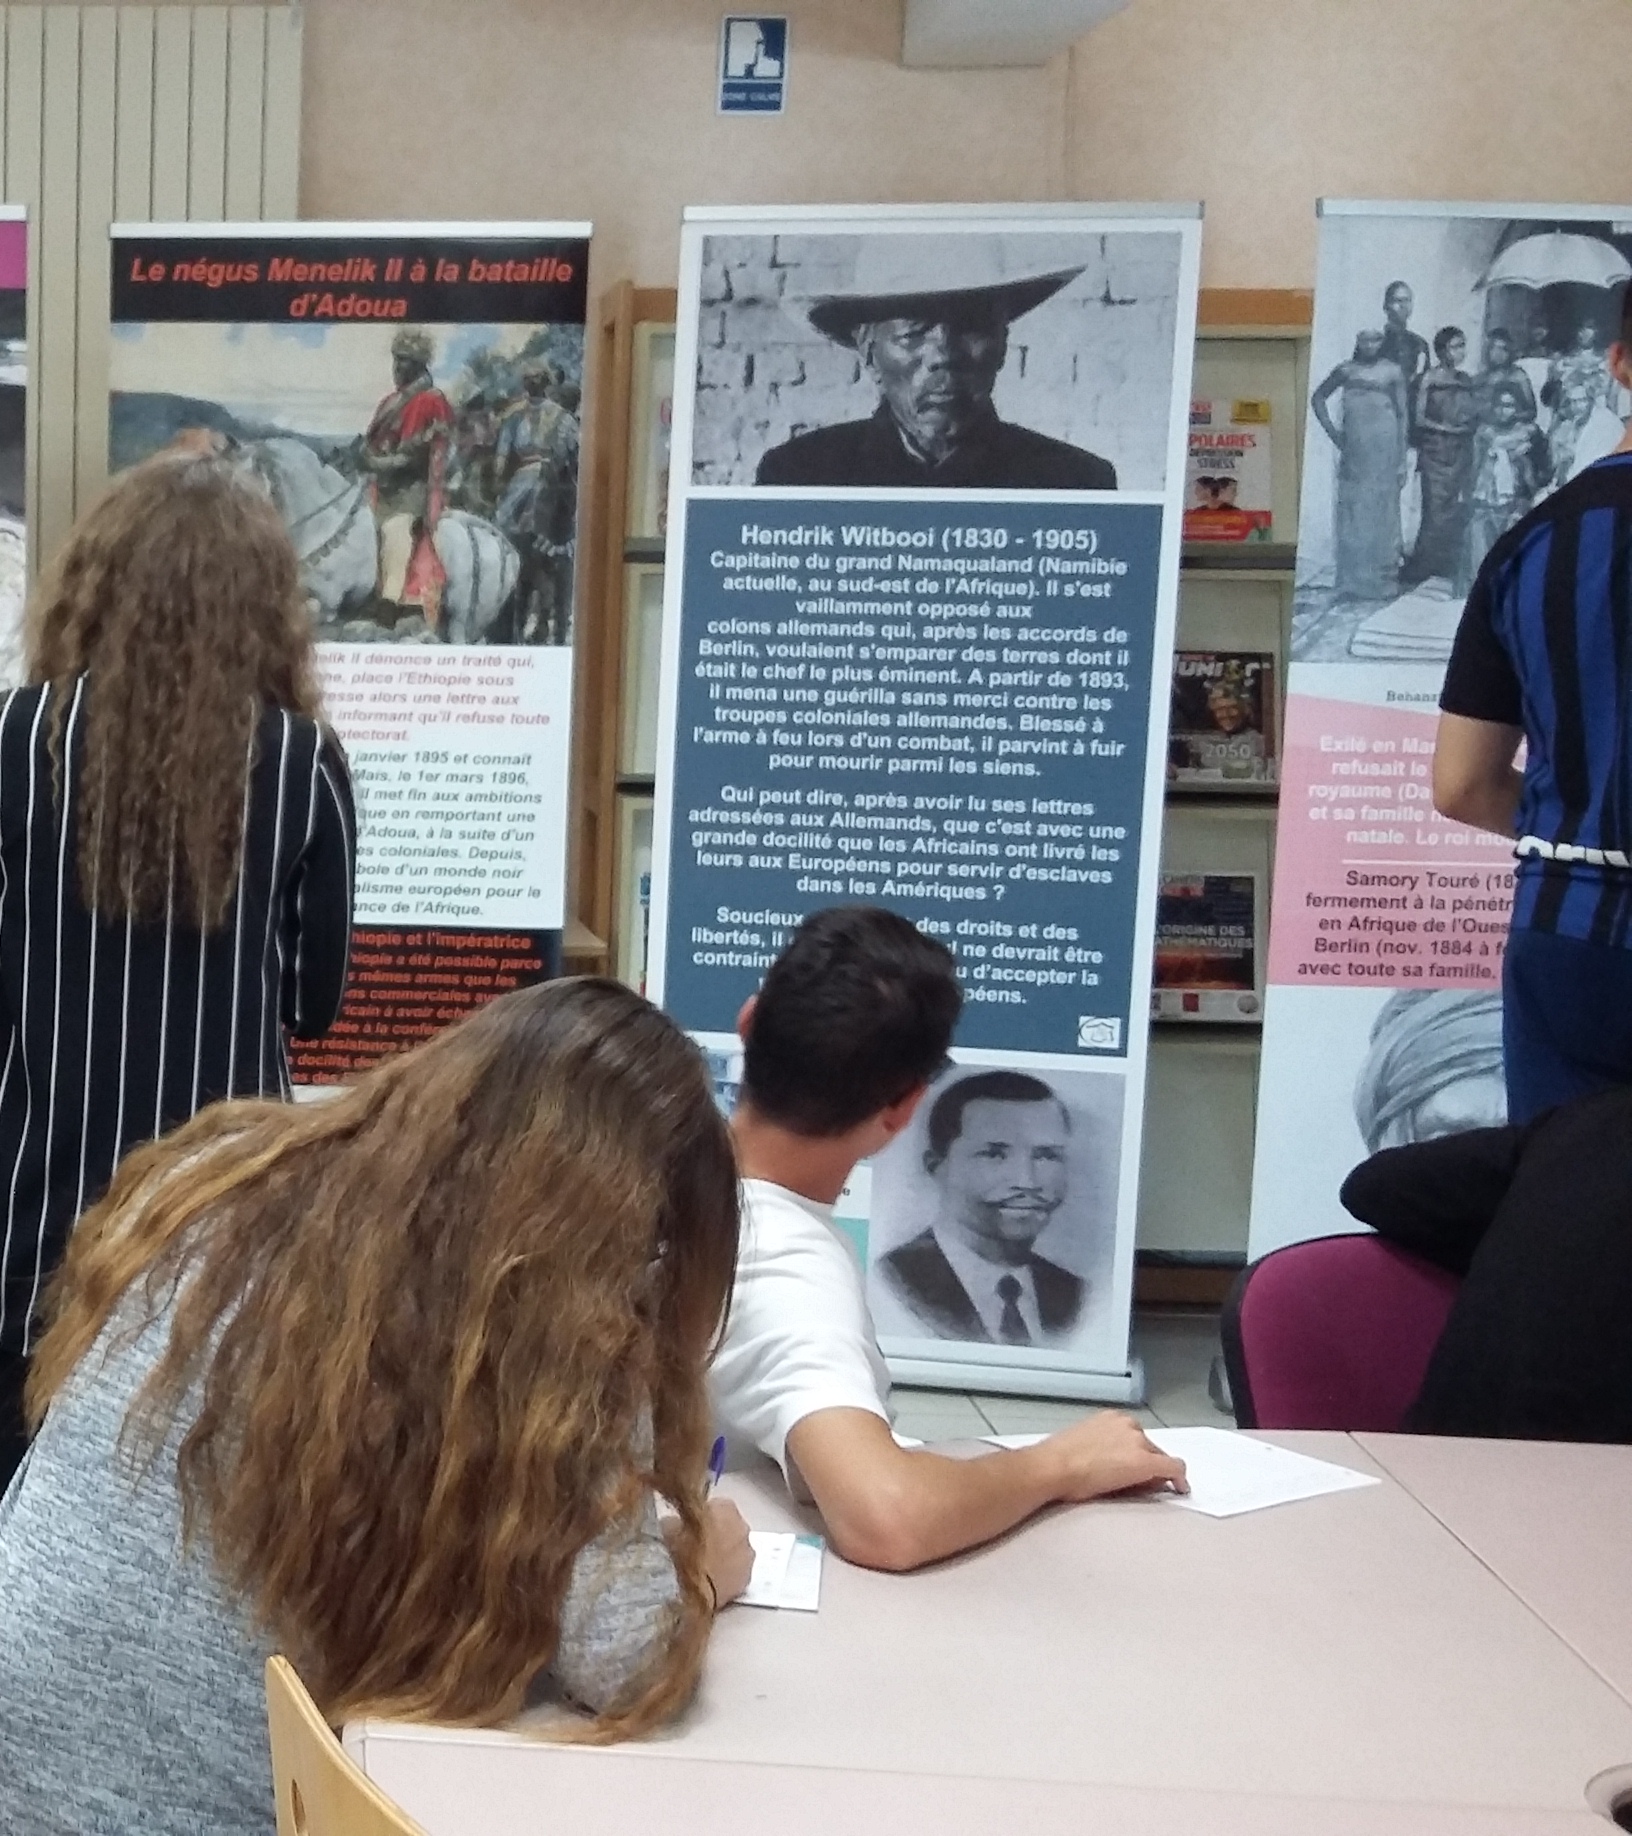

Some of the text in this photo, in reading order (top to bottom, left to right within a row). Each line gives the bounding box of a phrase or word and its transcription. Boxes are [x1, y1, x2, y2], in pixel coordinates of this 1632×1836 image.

[131, 258, 572, 287] Le négus Menelik II à la bataille
[291, 293, 407, 317] d'Adoua
[742, 525, 833, 545] Hendrik
[841, 526, 934, 547] Witbooi
[942, 528, 1007, 552] (1830
[1033, 529, 1097, 554] 1905)
[711, 551, 1127, 576] Capitaine du grand Namaqualand (Namibie
[796, 598, 1032, 620] vaillamment opposé aux
[699, 639, 1129, 666] Berlin, voulaient s'emparer des terres dont il
[1204, 742, 1250, 760] 2050
[1320, 735, 1395, 752] Exilé en
[353, 751, 532, 766] janvier 1895 et connaît
[1332, 759, 1427, 777] refusait le
[398, 771, 411, 781] le
[419, 770, 441, 782] 1er
[446, 774, 483, 783] mars
[490, 771, 529, 786] 1896,
[374, 790, 403, 800] met
[408, 789, 426, 800] fin
[432, 792, 459, 801] aux
[465, 791, 542, 803] ambitions
[797, 876, 1005, 902] dans les Amériques ?
[1346, 871, 1479, 891] Samory Touré
[1306, 893, 1445, 910] fermement à la
[717, 907, 1079, 940] Soucieux des droits et des
[406, 933, 423, 945] et
[1315, 938, 1489, 957] Berlin (nov. 1884 à
[1298, 963, 1496, 979] avec toute sa famille.
